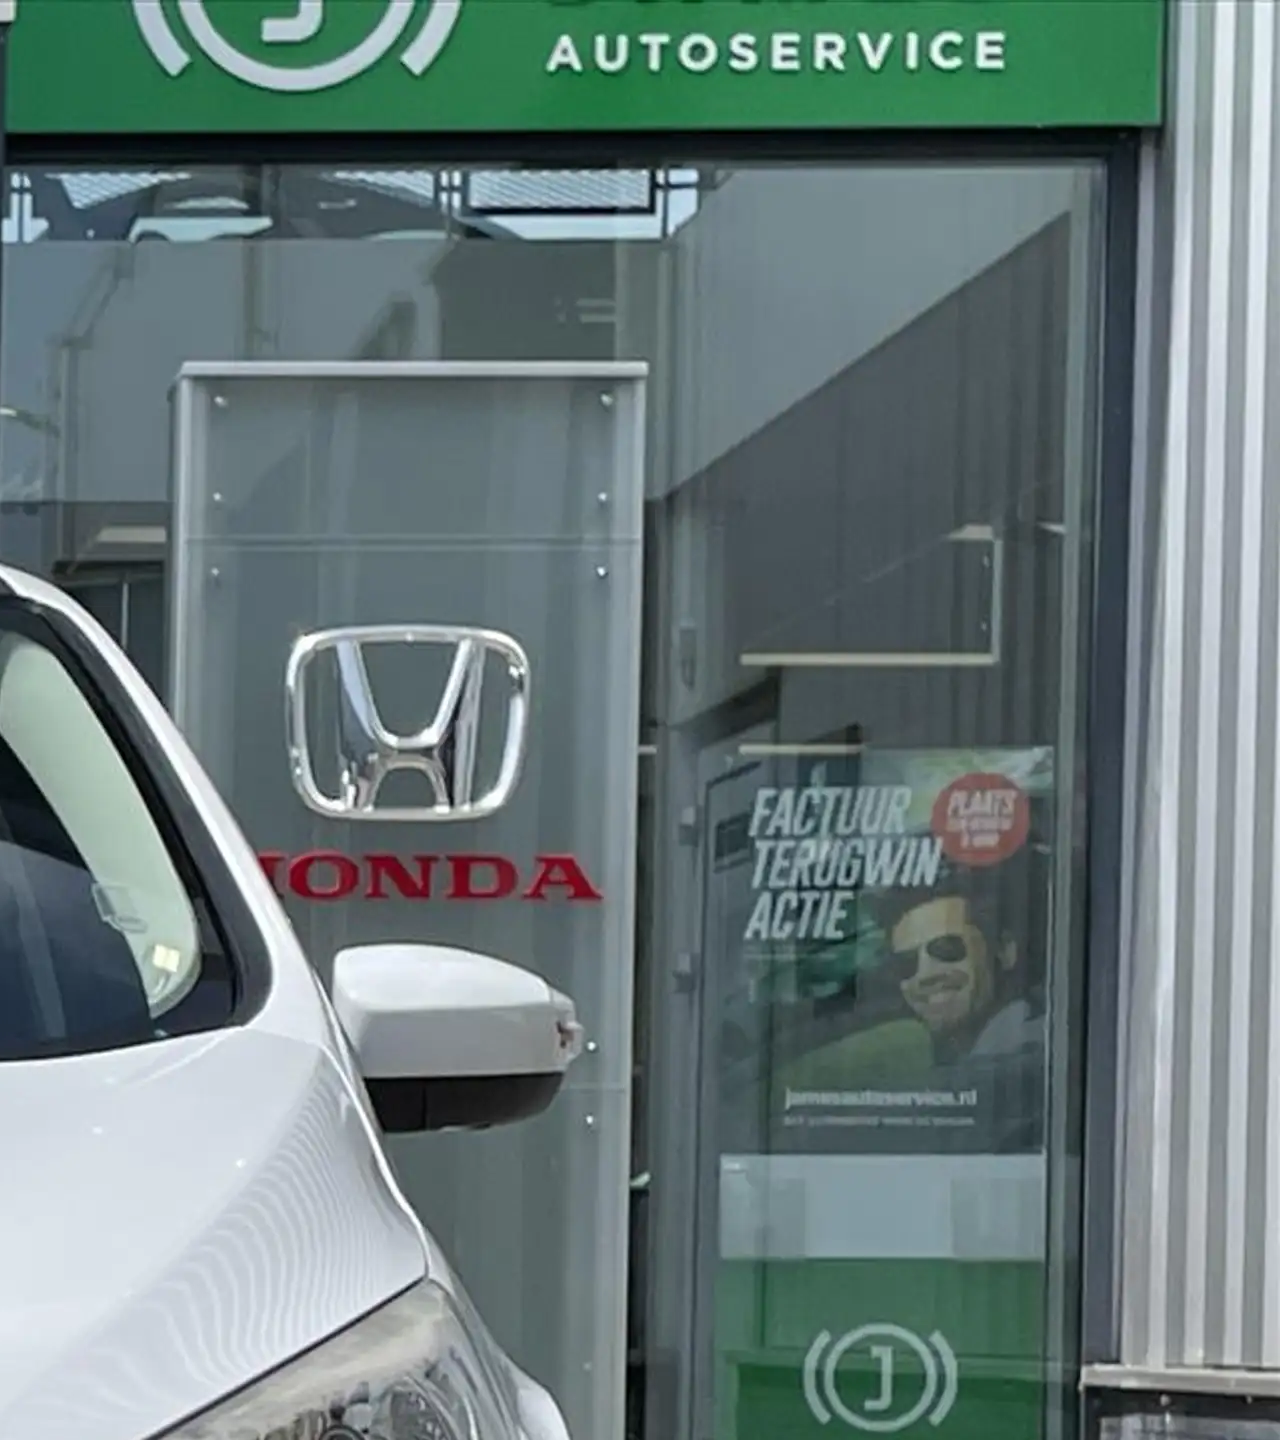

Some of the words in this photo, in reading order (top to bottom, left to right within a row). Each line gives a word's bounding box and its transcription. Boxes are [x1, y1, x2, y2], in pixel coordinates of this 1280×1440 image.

[545, 31, 1007, 72] AUTOSERVICE
[748, 785, 913, 837] FACTUUR
[256, 851, 604, 901] ONDA
[751, 836, 943, 889] TERUGWIN
[743, 890, 855, 939] ACTIE
